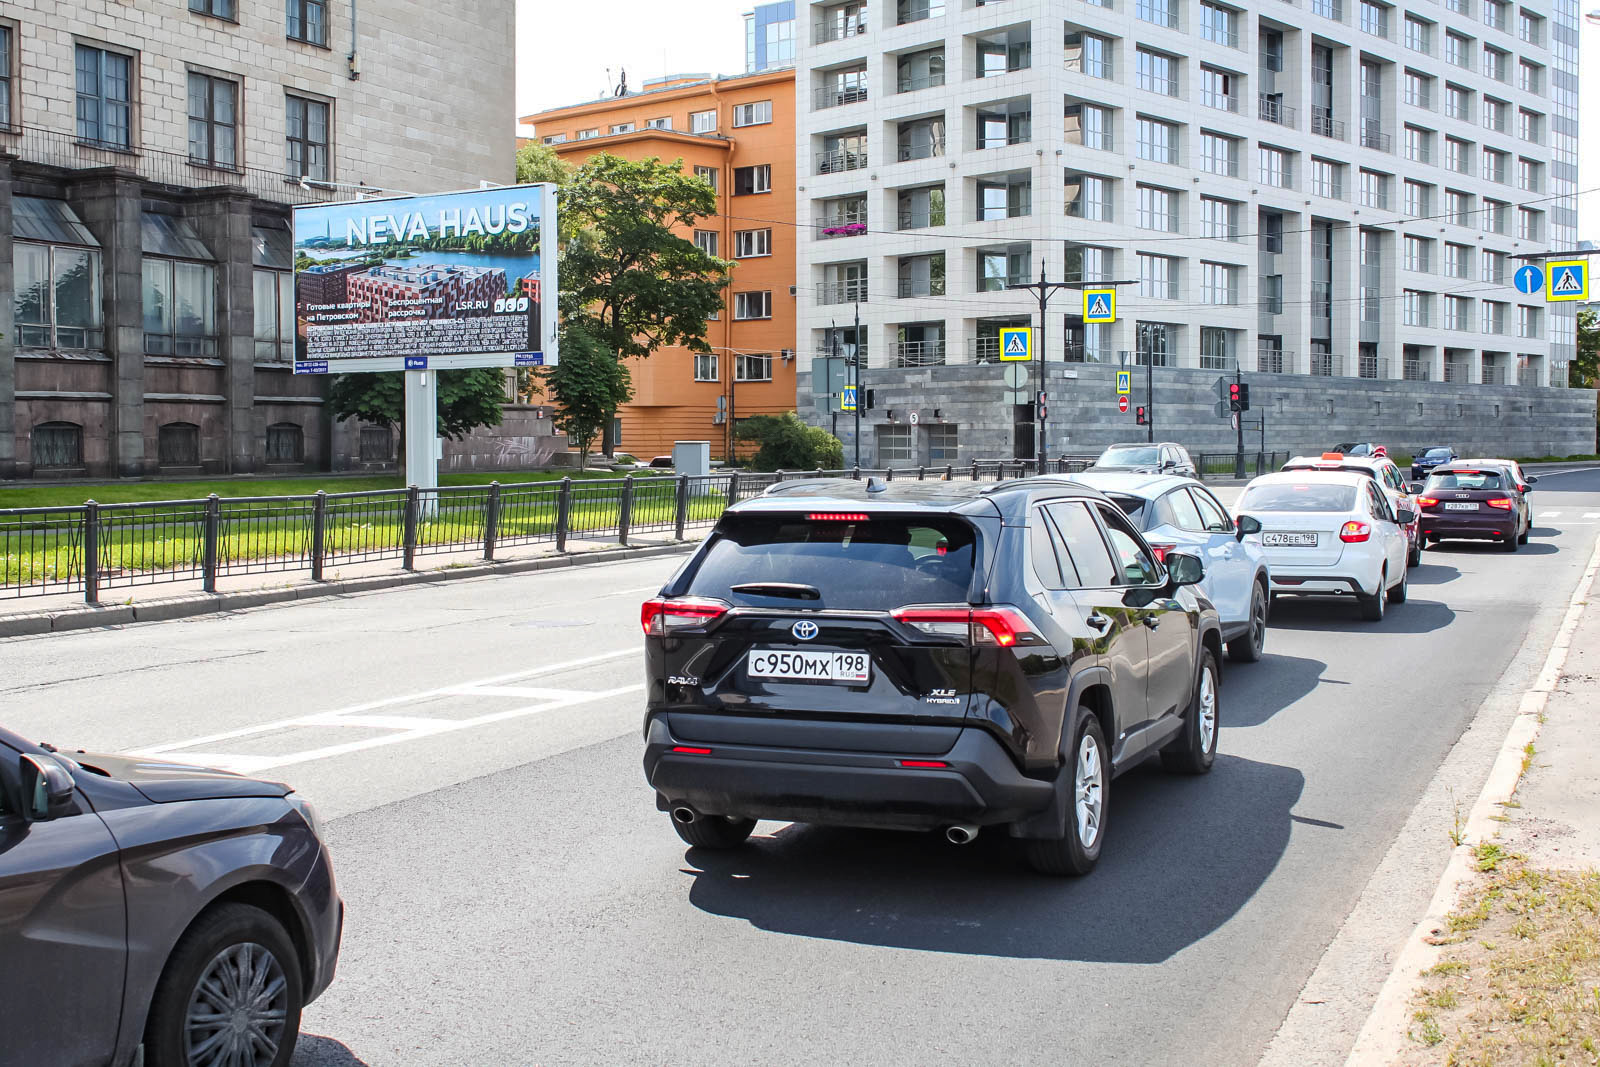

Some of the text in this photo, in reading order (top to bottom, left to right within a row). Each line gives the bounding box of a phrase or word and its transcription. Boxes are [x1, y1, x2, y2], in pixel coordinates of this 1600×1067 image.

[347, 202, 528, 246] NEVA HAUS
[306, 302, 372, 311] Готовые квартиры
[388, 297, 443, 307] Беспроцентная
[455, 300, 489, 311] LSR.RU
[316, 312, 359, 322] Петровском
[388, 309, 426, 319] рассрочка
[835, 655, 864, 671] 198
[930, 689, 957, 697] XLE
